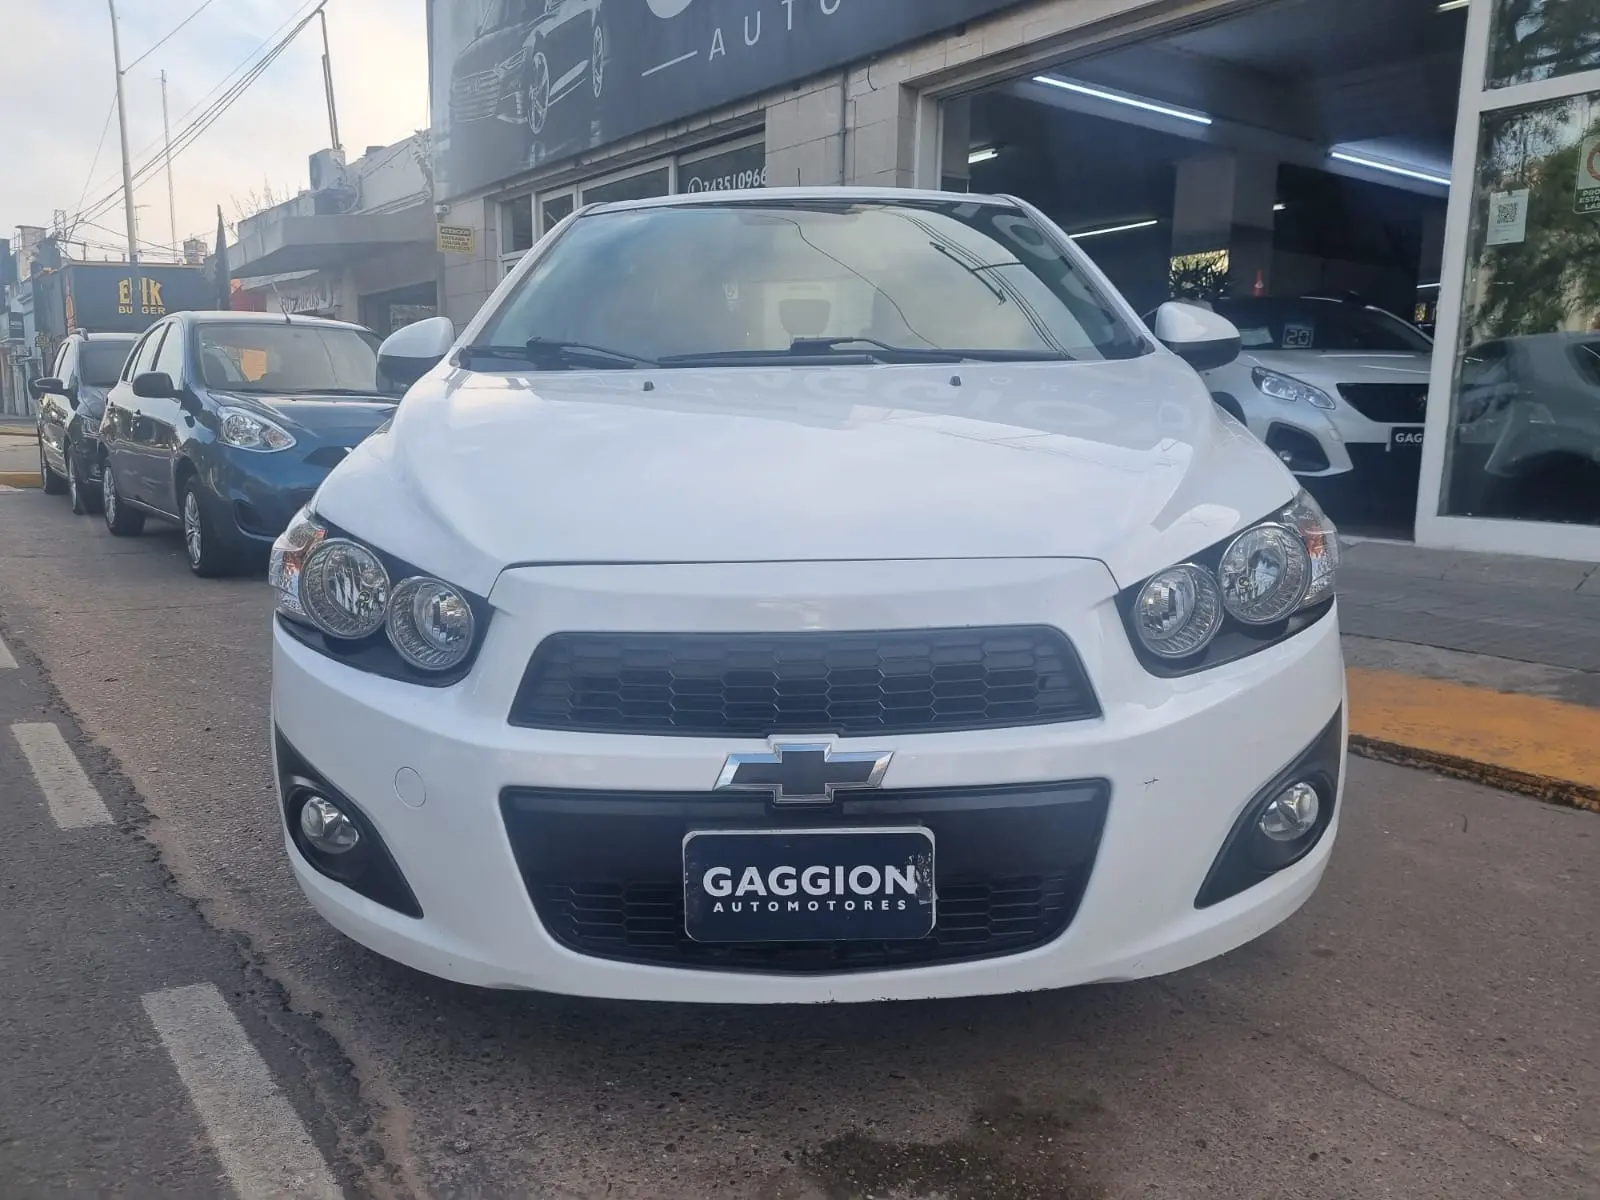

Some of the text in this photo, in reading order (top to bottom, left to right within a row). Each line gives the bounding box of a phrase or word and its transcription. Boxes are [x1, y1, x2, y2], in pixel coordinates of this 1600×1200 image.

[118, 306, 166, 315] BUGER
[702, 865, 918, 897] GAGGION
[712, 899, 907, 913] AUTOMOTORES
